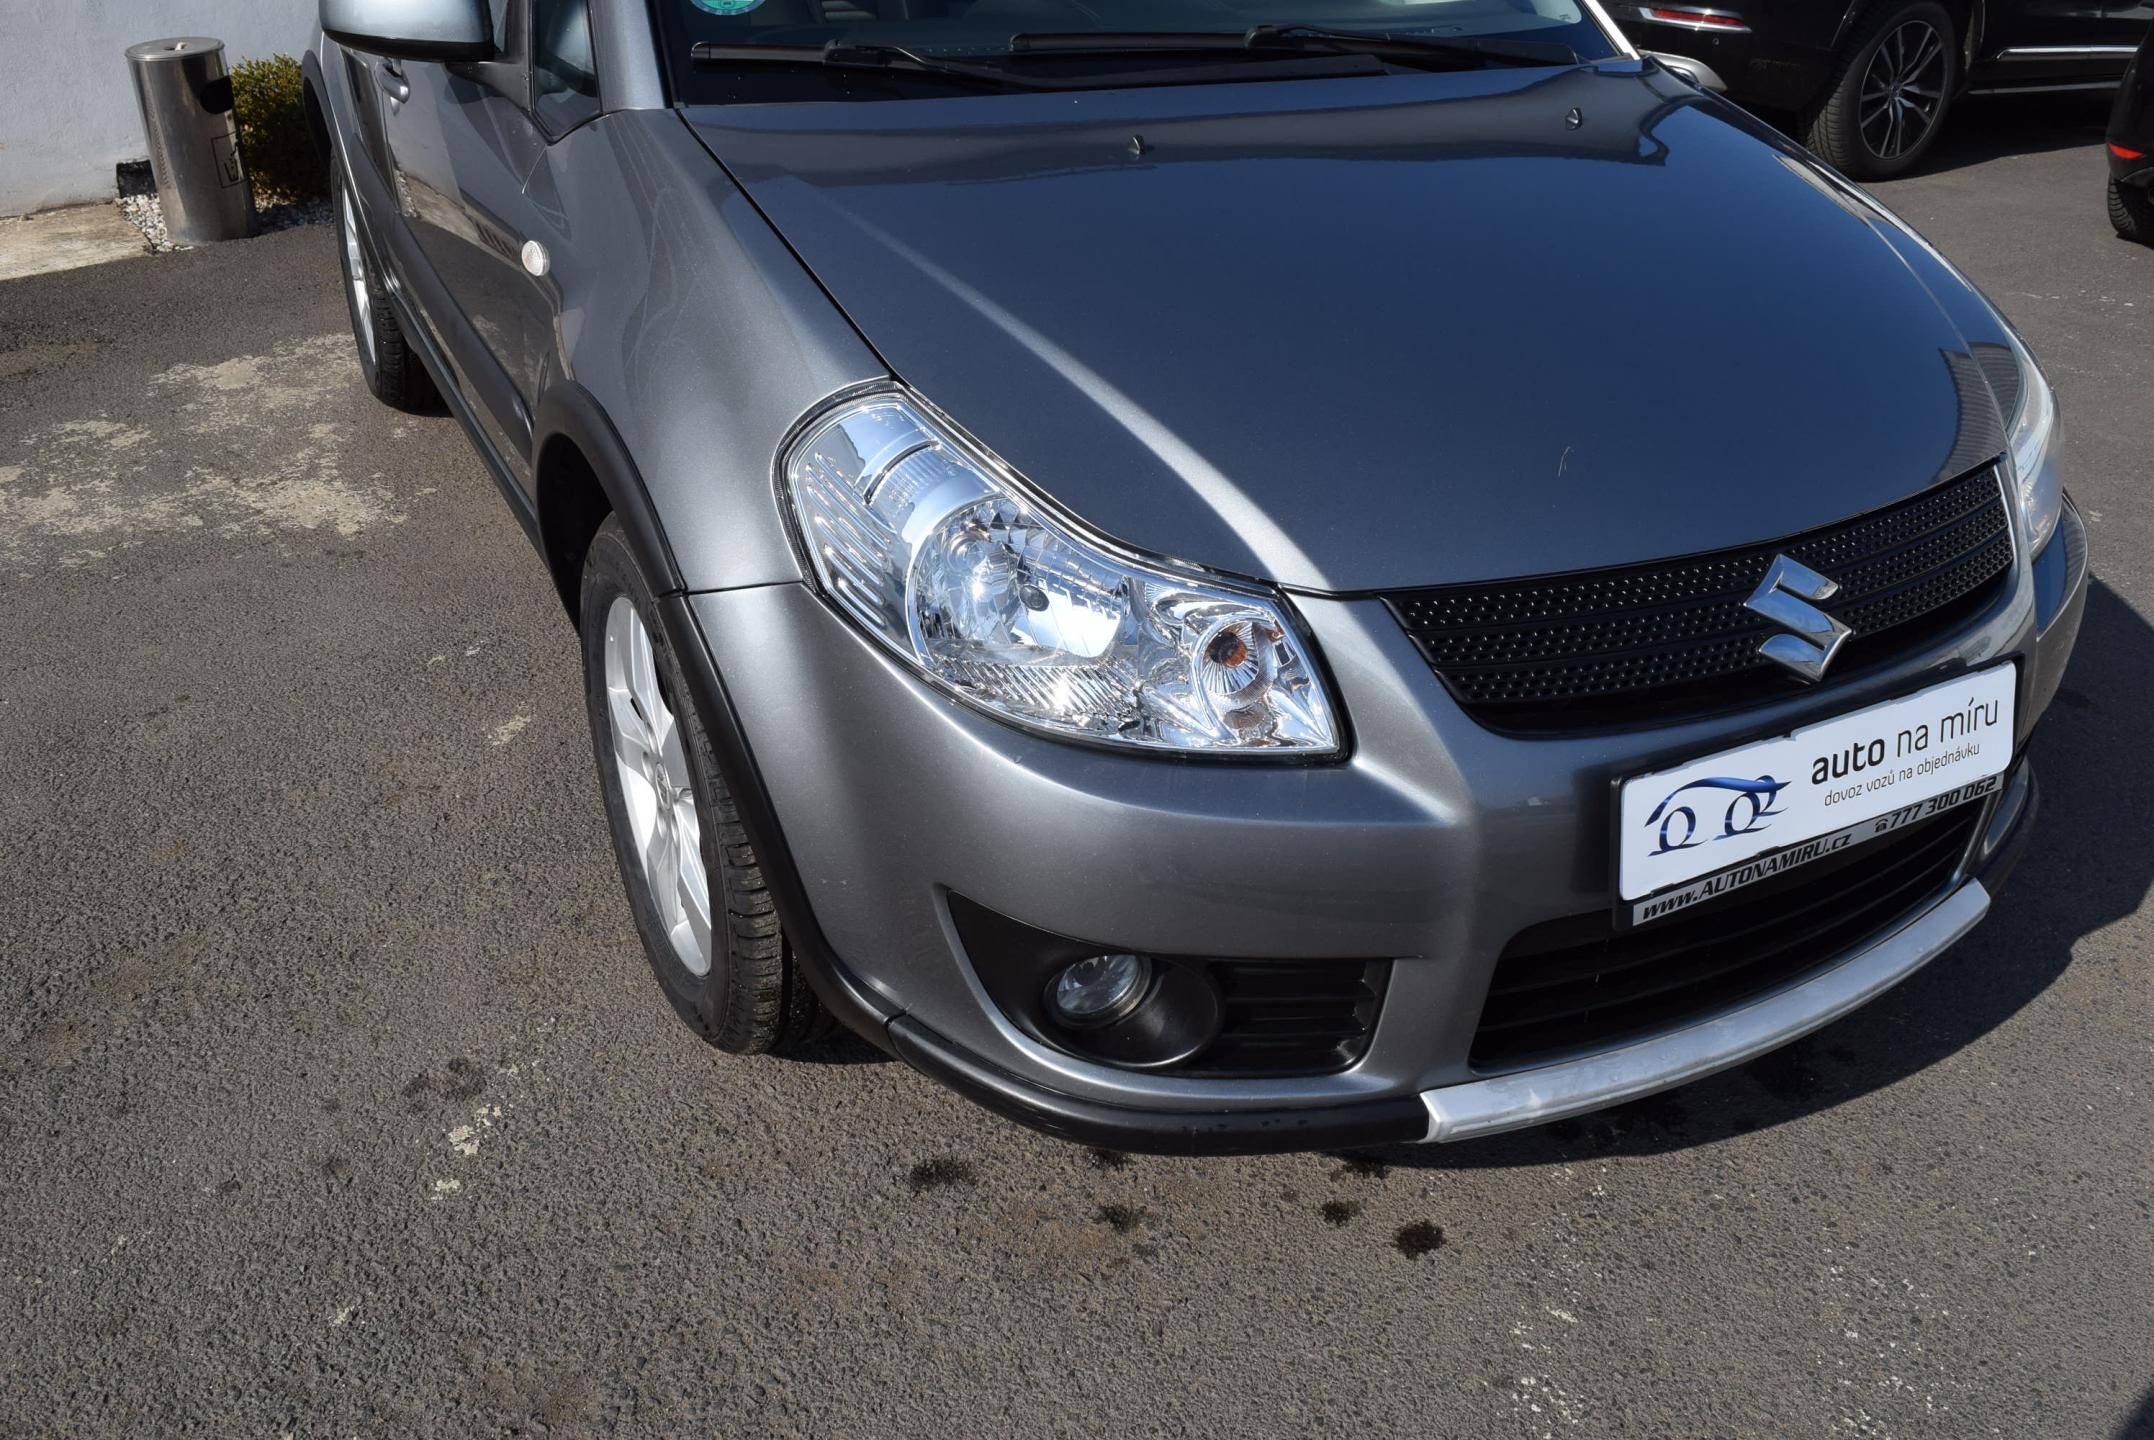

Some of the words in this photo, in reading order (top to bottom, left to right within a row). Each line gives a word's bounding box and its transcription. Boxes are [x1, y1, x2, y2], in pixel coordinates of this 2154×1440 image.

[1811, 738, 1886, 785] auto
[1896, 724, 1929, 759] na
[1940, 697, 1999, 743] míru
[1824, 784, 1863, 807] dovoz
[1866, 769, 1896, 793] vozů
[1899, 767, 1914, 783] na
[1916, 742, 1980, 775] objednávku
[1890, 803, 1923, 829] 777
[1925, 790, 1961, 816] 300
[1963, 776, 1998, 801] 062
